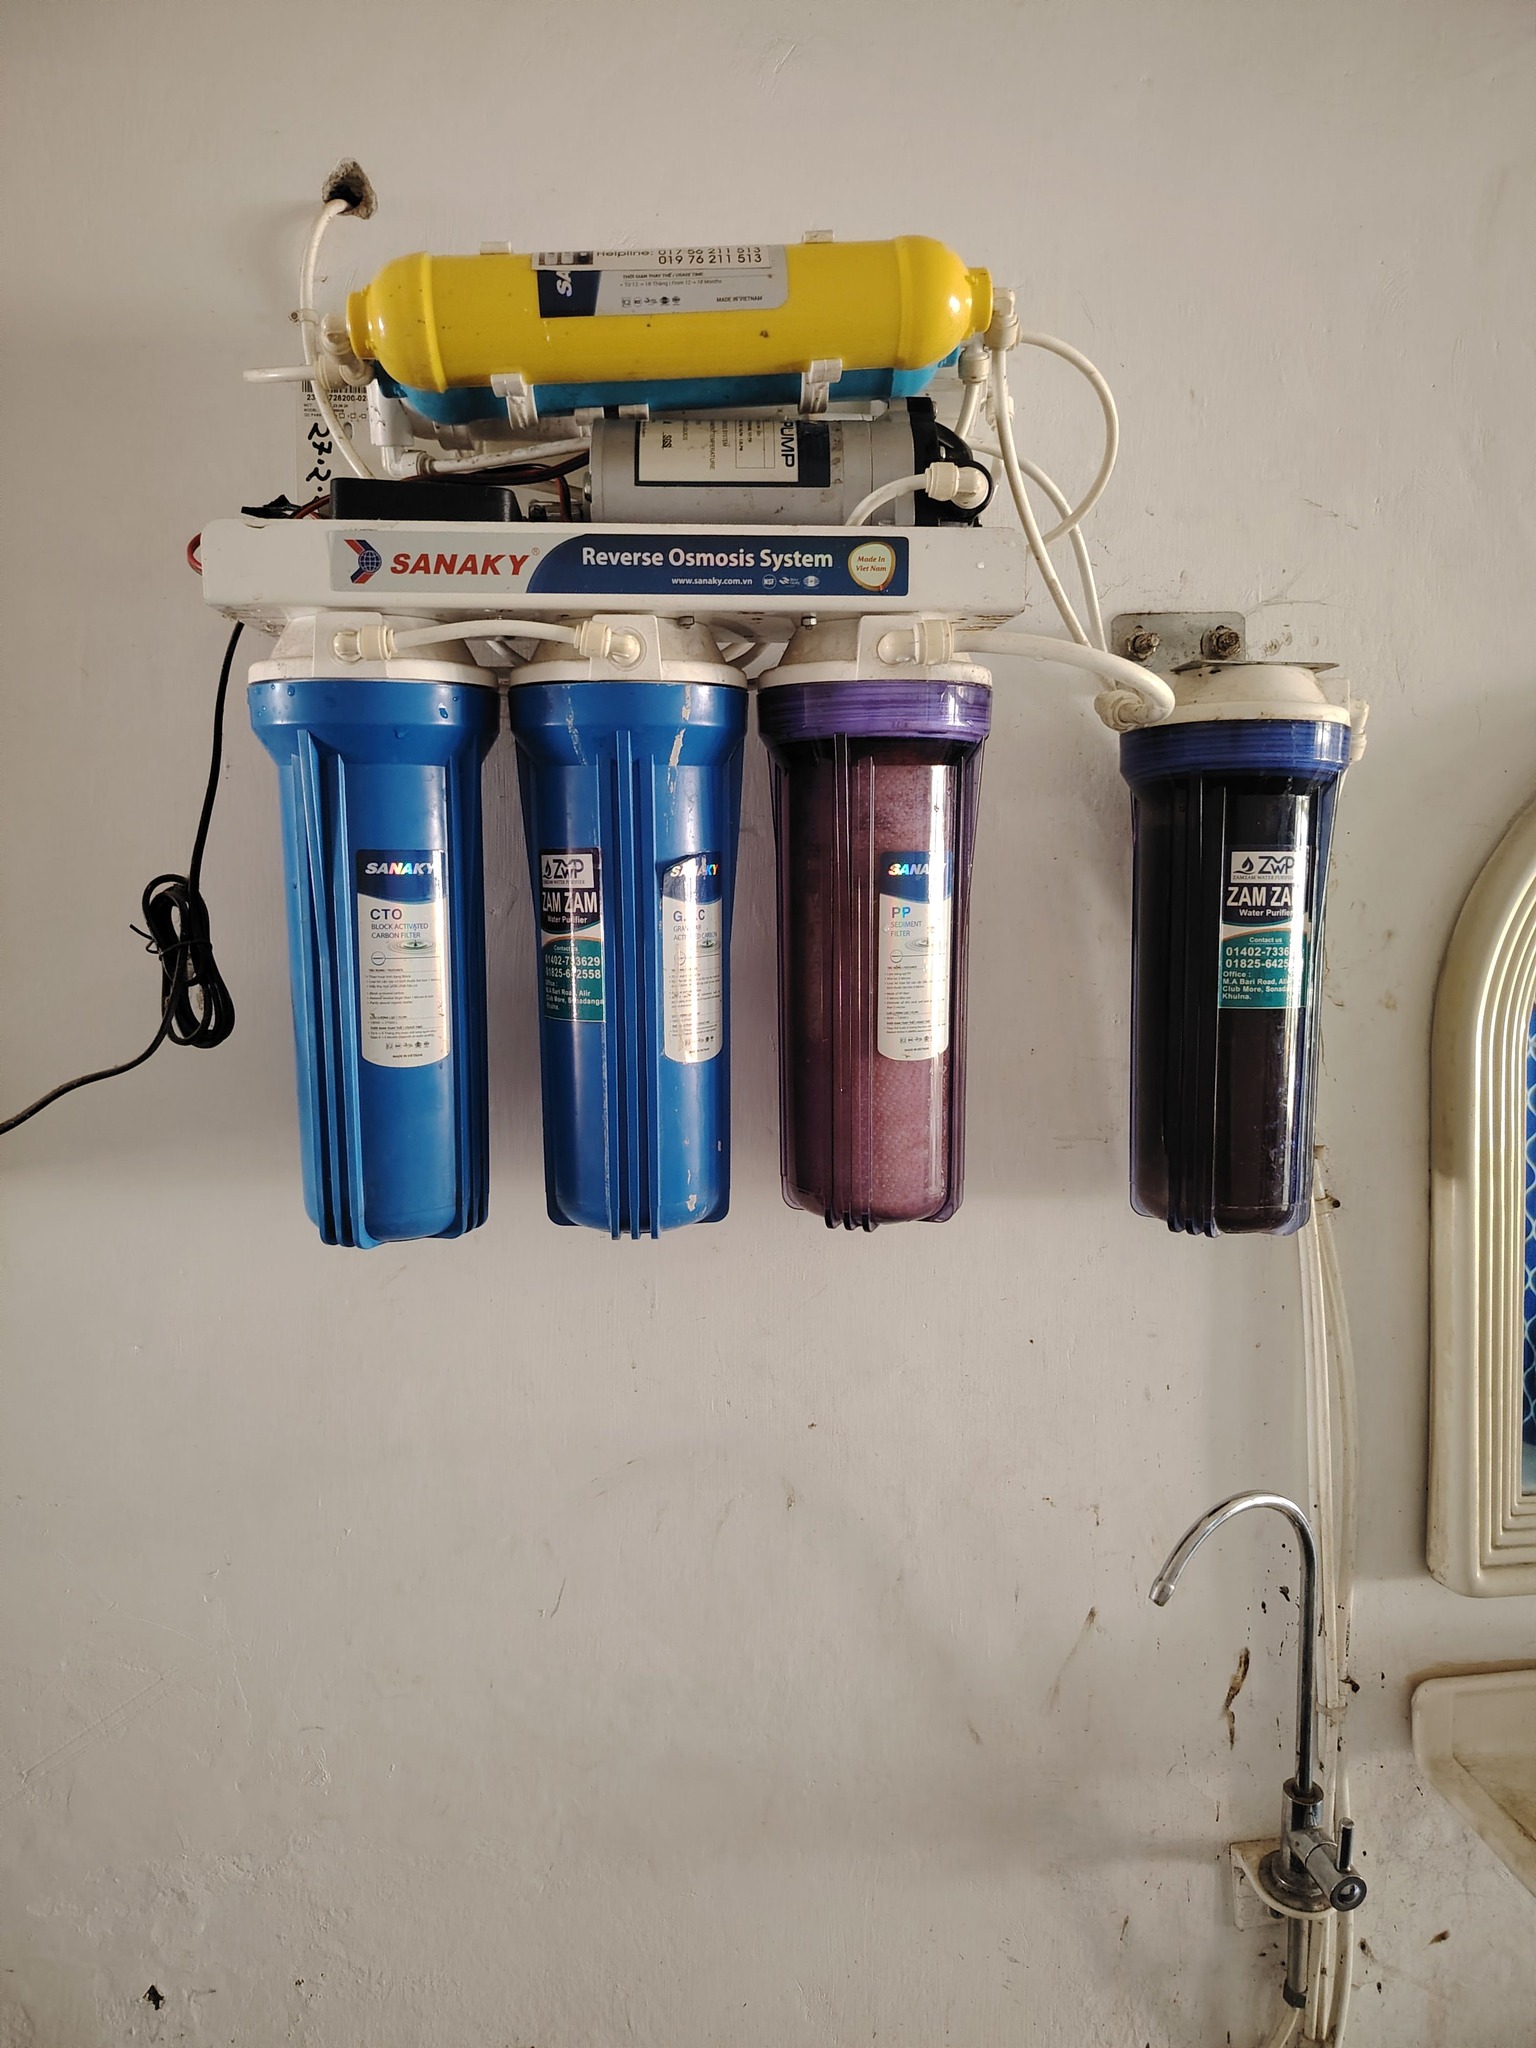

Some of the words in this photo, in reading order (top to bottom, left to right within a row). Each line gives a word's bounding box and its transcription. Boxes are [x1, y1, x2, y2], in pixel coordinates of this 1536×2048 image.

[658, 255, 683, 265] 019
[689, 255, 704, 264] 76
[709, 254, 731, 264] 211
[737, 254, 762, 263] 513
[390, 552, 530, 576] SANAKY
[582, 547, 664, 567] Reverse
[668, 548, 755, 568] Osmosis
[760, 548, 833, 572] System
[671, 577, 753, 588] www.sanaky.com.vn
[365, 862, 435, 875] SANAKY
[669, 863, 718, 878] SAKY
[888, 863, 929, 876] SANA
[542, 891, 561, 912] ZAM
[564, 891, 598, 913] ZAM
[1226, 886, 1267, 907] ZAM
[1270, 886, 1292, 907] ZA
[370, 908, 403, 920] CTO
[673, 909, 705, 922] G..C
[891, 906, 911, 919] PP
[1239, 908, 1264, 917] Water
[562, 915, 588, 924] Puifier
[890, 920, 922, 928] SEDIMENT
[394, 922, 429, 930] ACTIVATED
[1225, 946, 1290, 957] 01402-7336
[1225, 958, 1289, 968] 01825-6425
[545, 966, 601, 979] 01825-62558
[1222, 970, 1246, 978] Office
[1257, 978, 1277, 986] Road,
[561, 989, 577, 997] Roa,
[1242, 985, 1264, 993] More,
